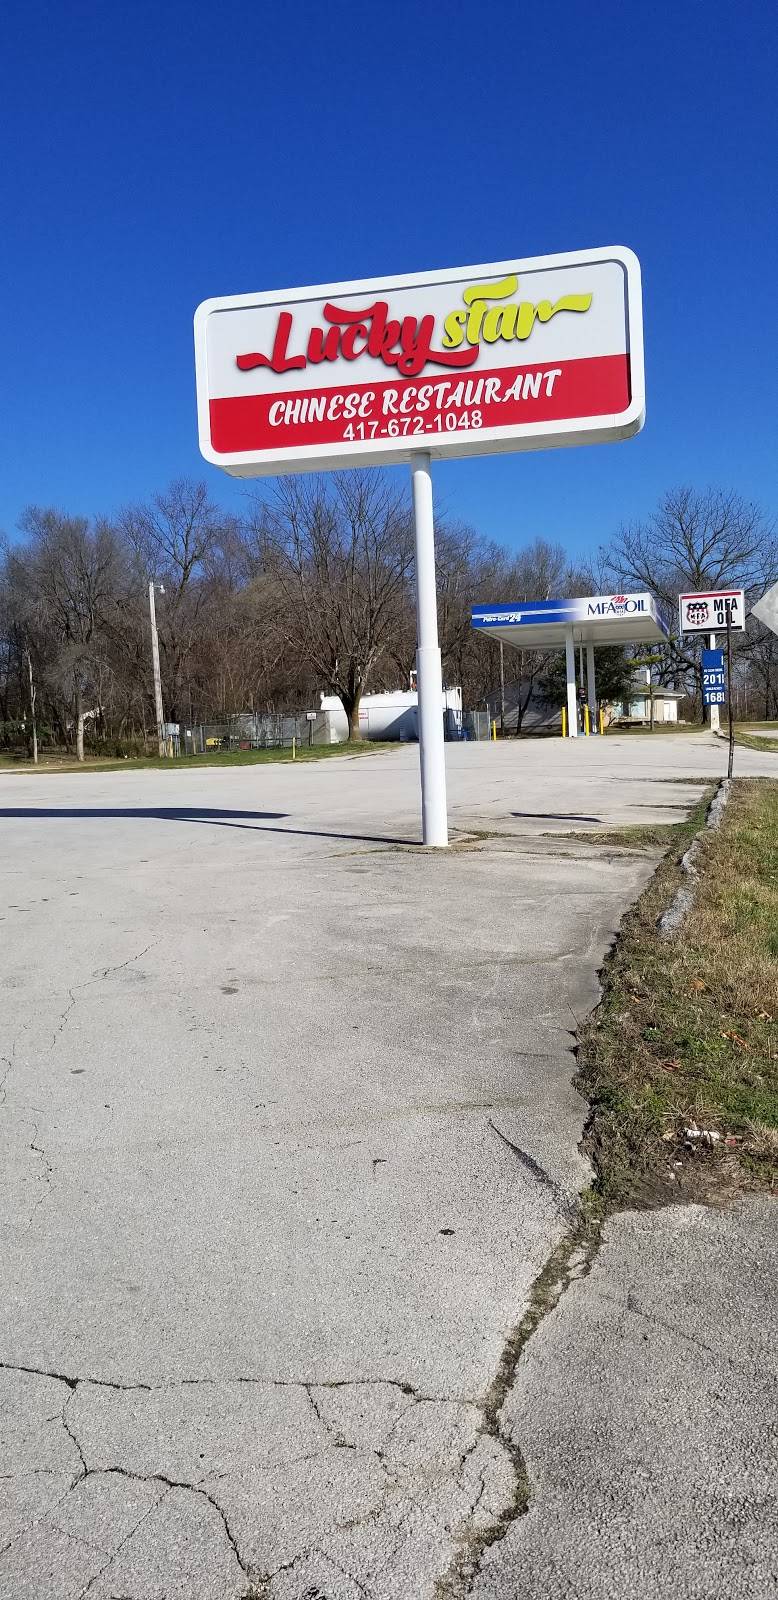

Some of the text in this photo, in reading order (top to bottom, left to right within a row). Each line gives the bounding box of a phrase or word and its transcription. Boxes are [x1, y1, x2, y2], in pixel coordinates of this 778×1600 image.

[236, 275, 593, 376] Lucky star
[268, 370, 561, 427] CHINESE RESTAURANT
[343, 410, 483, 441] 417-672-1048
[587, 602, 616, 615] MFA
[625, 600, 648, 612] OIL
